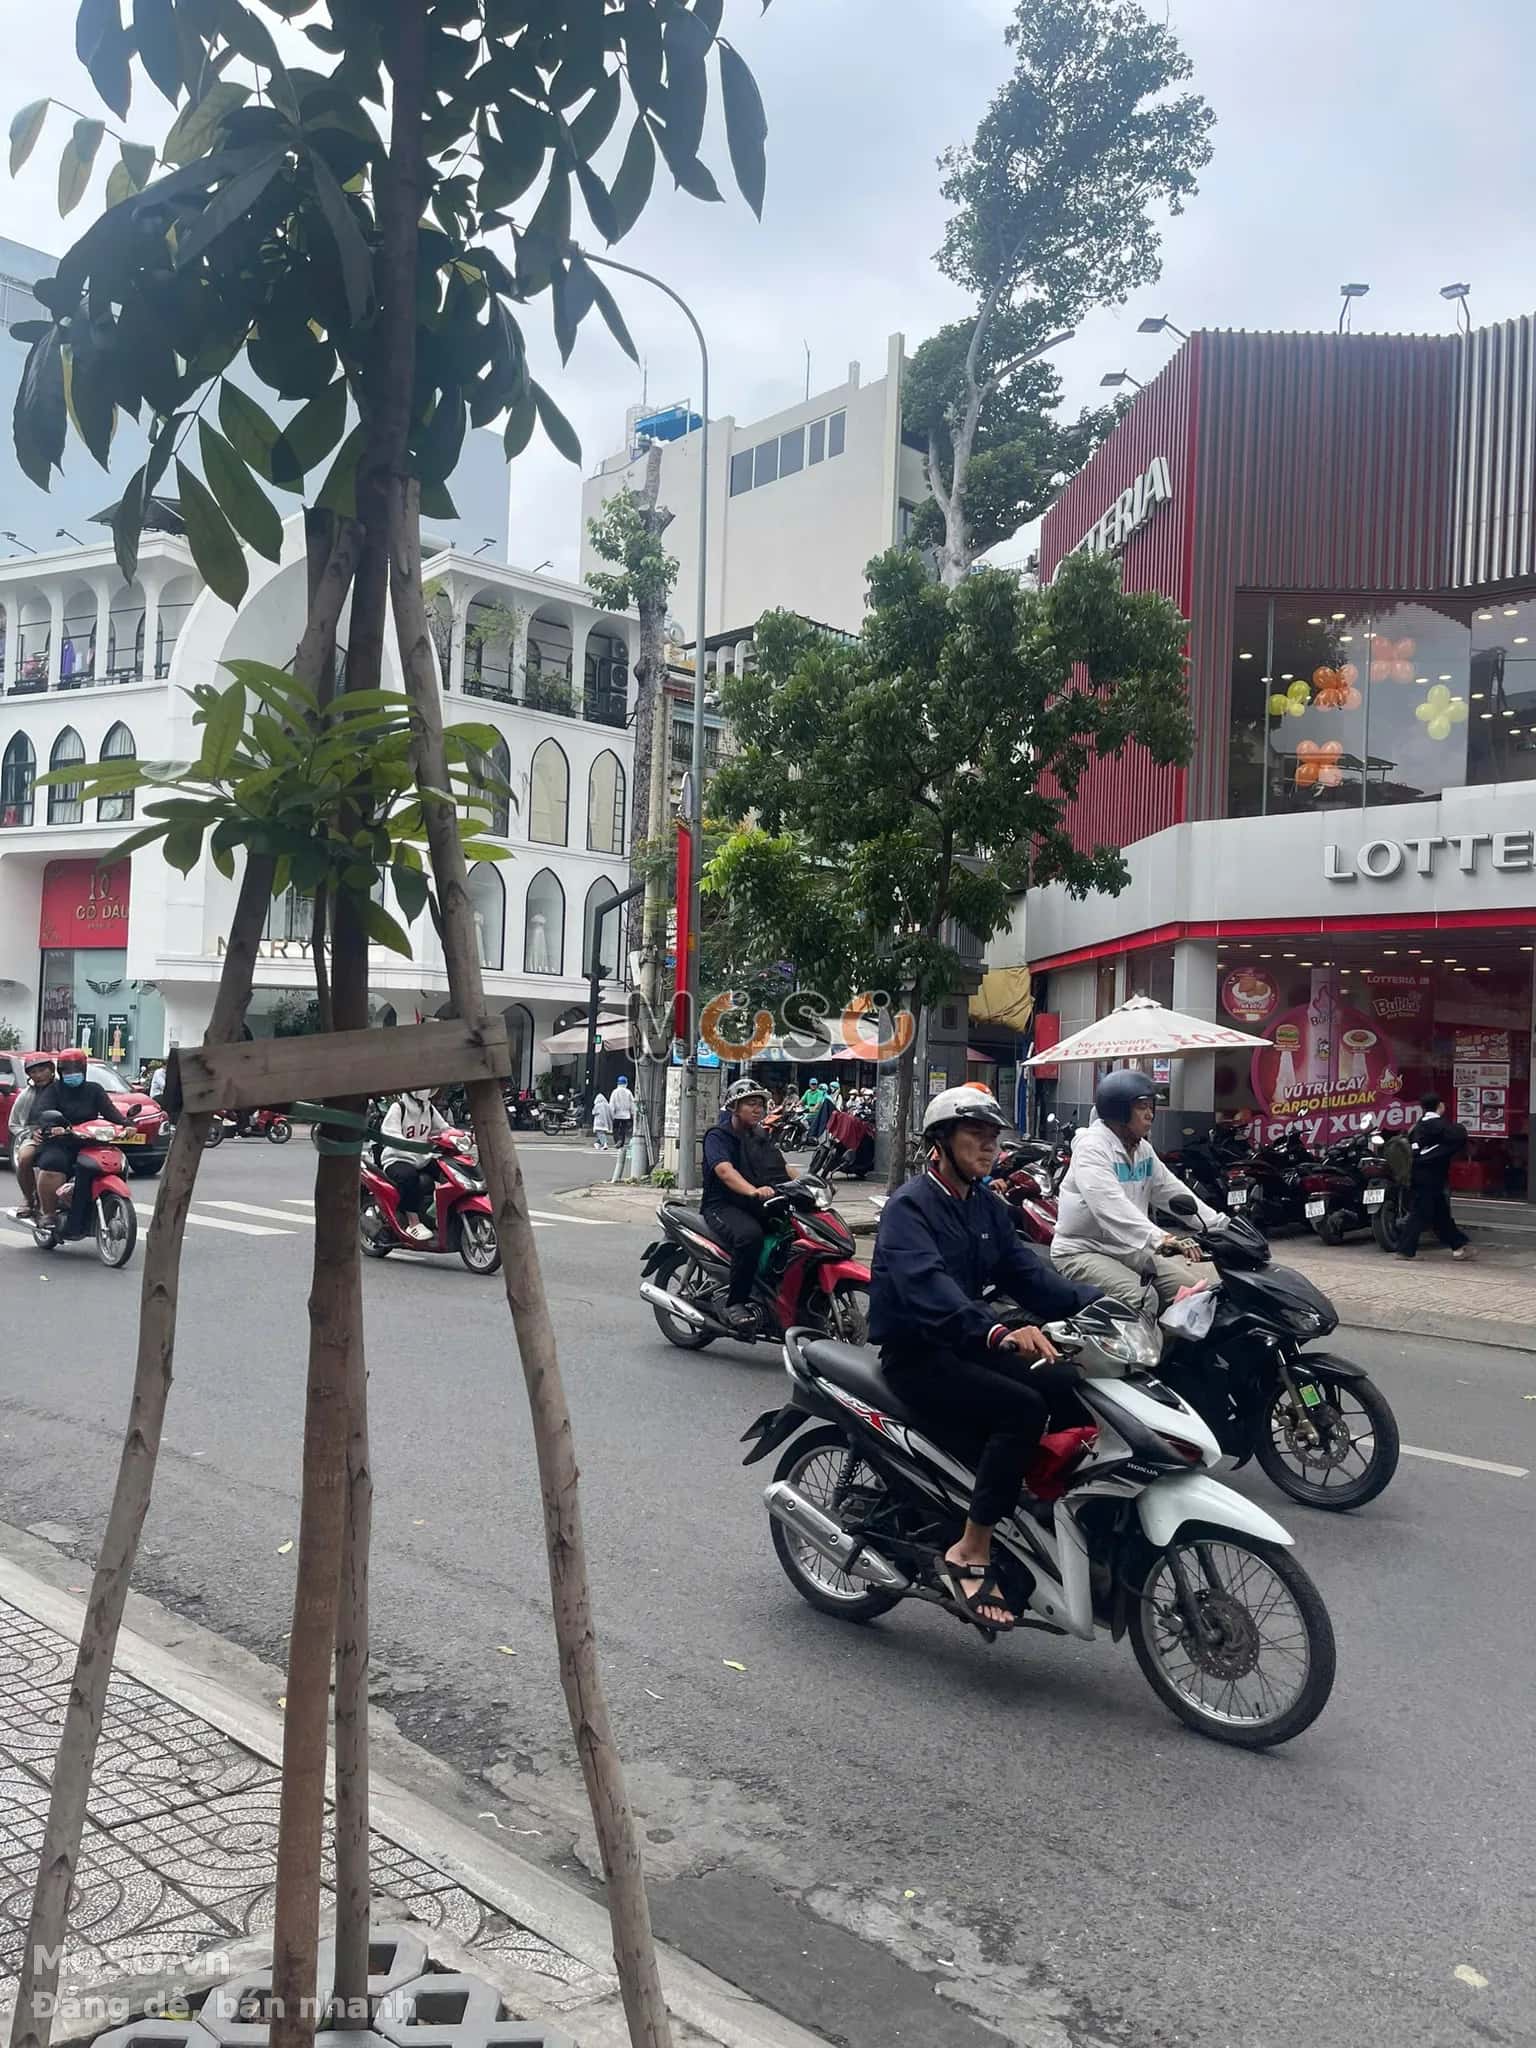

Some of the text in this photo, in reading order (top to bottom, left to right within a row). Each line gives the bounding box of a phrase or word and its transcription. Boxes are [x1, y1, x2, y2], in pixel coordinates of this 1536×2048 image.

[1323, 830, 1536, 880] LOTTE
[1335, 1076, 1365, 1091] CAY
[1321, 1090, 1376, 1108] BULDAK
